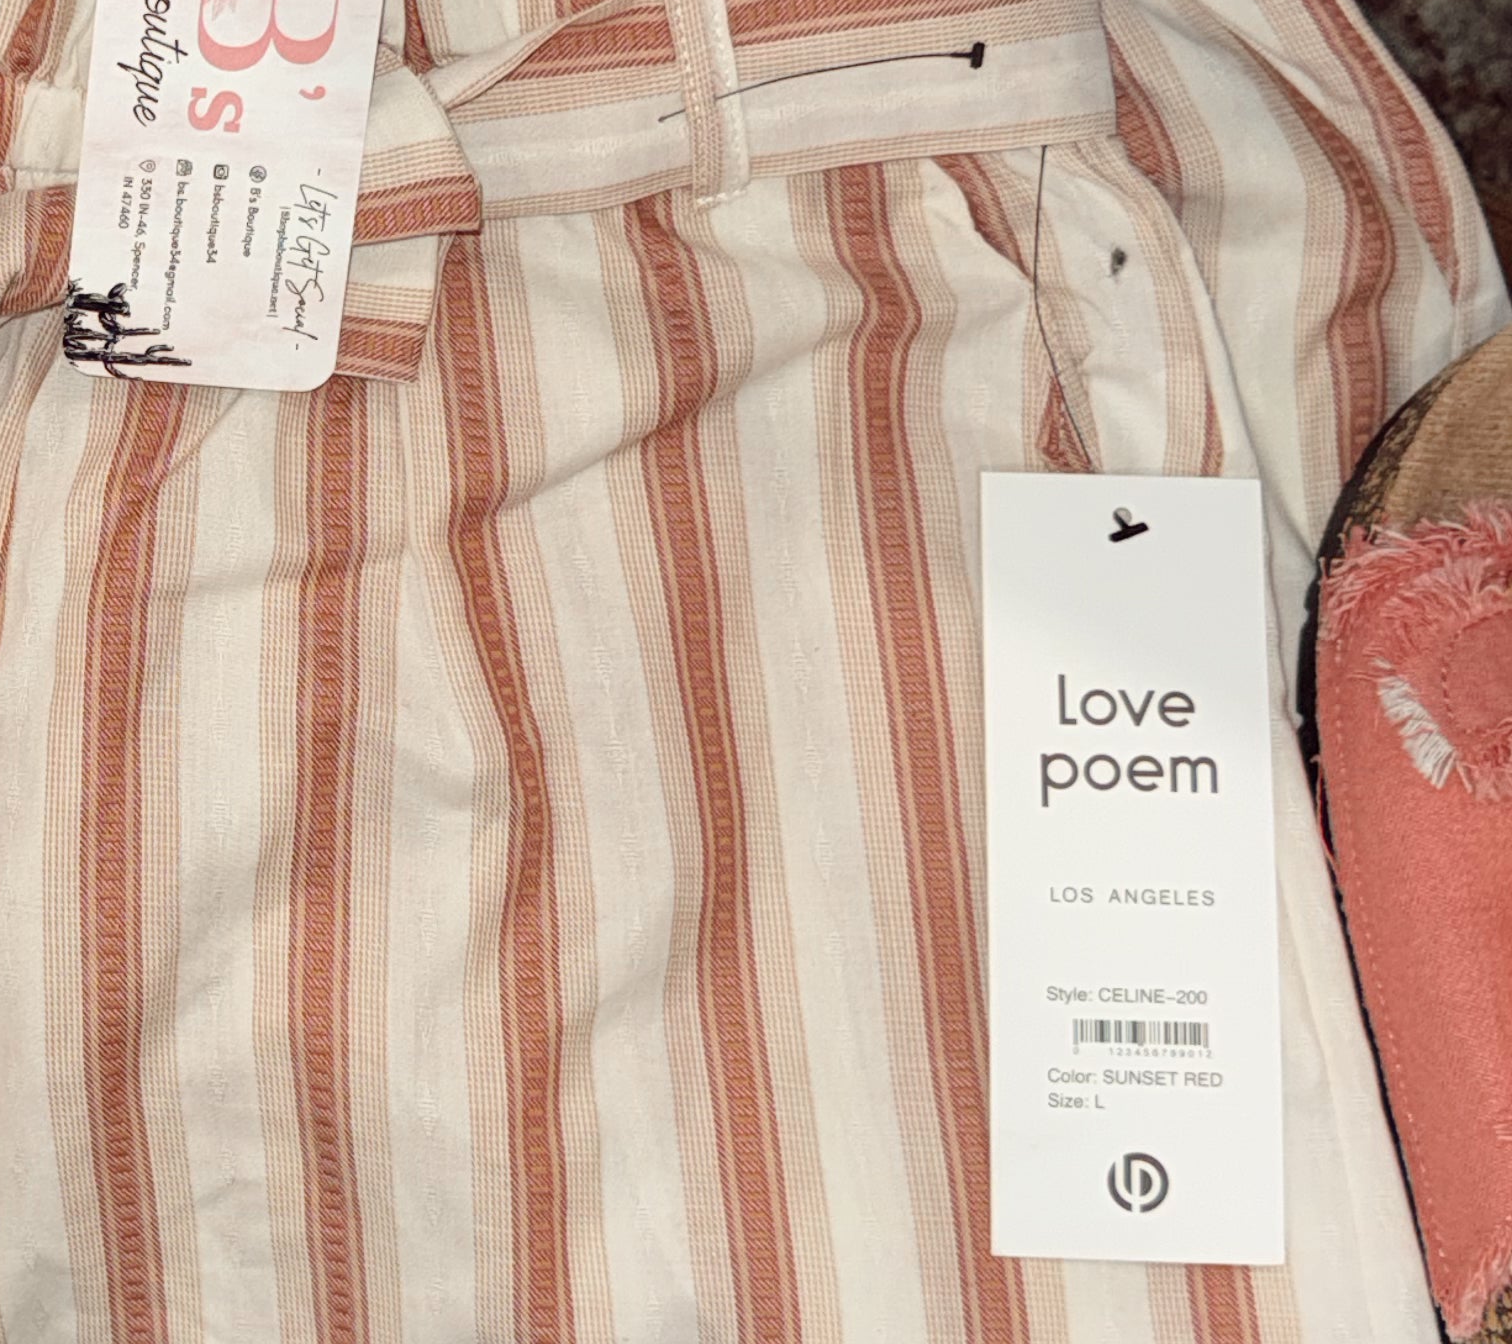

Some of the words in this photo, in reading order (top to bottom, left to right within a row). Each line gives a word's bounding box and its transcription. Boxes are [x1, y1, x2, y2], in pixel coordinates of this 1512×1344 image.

[123, 176, 134, 188] IN
[118, 192, 133, 229] 47460
[206, 184, 226, 264] bsboutique34
[242, 207, 259, 257] Boutique
[293, 184, 338, 232] Let's
[287, 235, 331, 286] Get
[282, 278, 324, 340] Social
[1057, 673, 1196, 728] Love
[1040, 753, 1219, 808] poem
[1049, 886, 1094, 904] LOS
[1108, 888, 1216, 907] ANGELES
[1046, 986, 1093, 1005] Style:
[1098, 987, 1208, 1005] CELINE-200
[1047, 1067, 1097, 1084] Color:
[1102, 1069, 1178, 1086] SUNSET
[1184, 1071, 1223, 1087] RED
[1047, 1092, 1090, 1109] Size:
[1094, 1094, 1105, 1109] L
